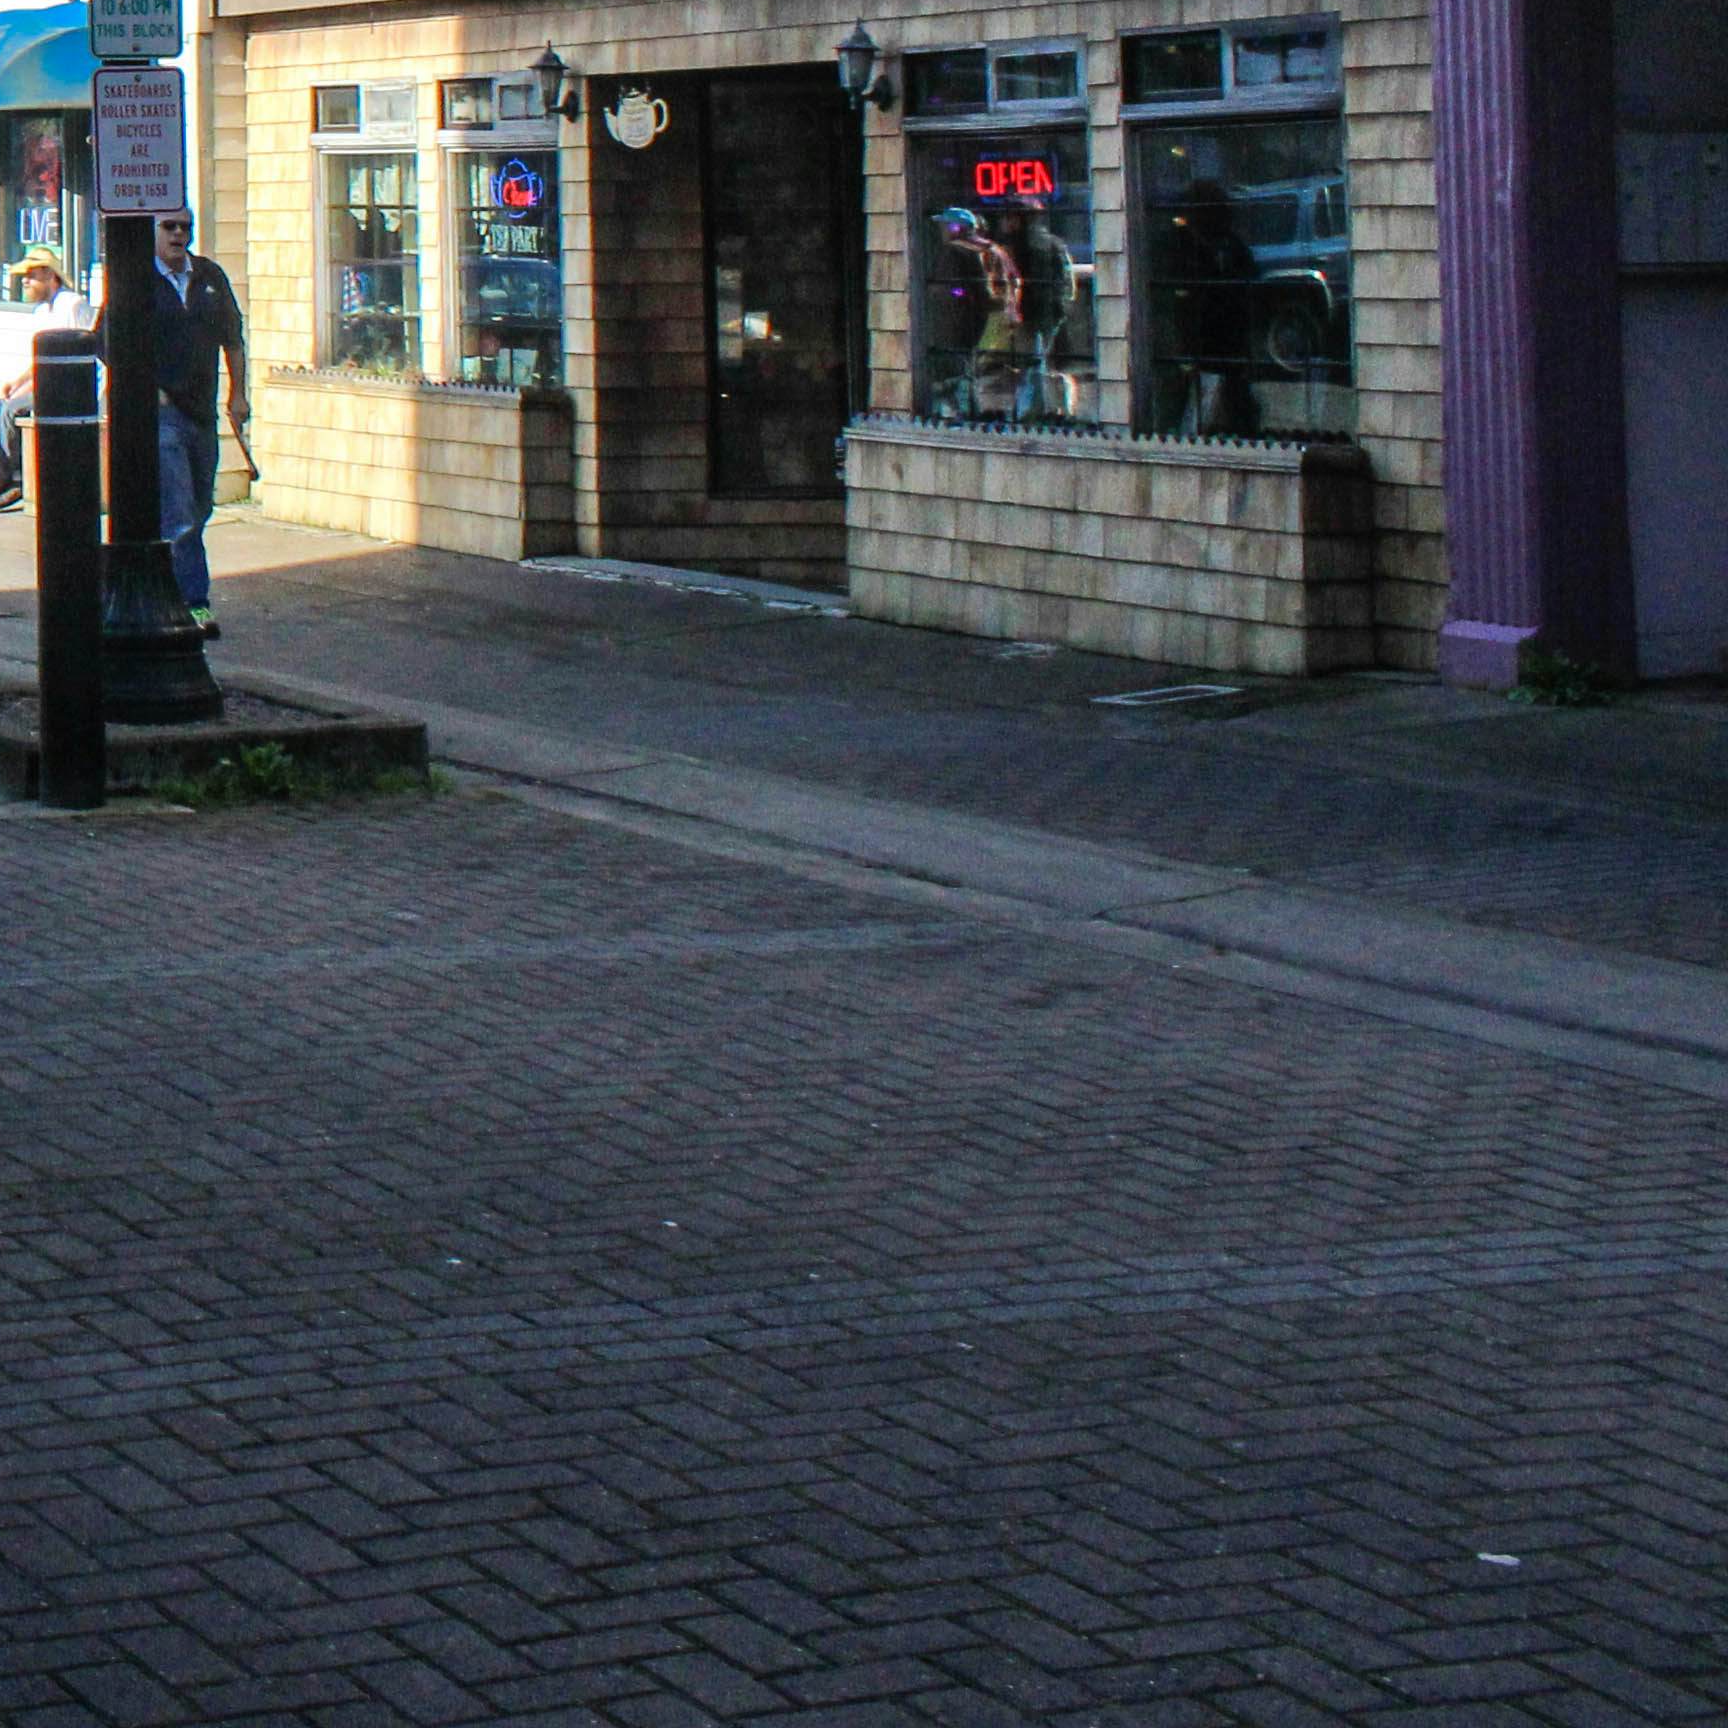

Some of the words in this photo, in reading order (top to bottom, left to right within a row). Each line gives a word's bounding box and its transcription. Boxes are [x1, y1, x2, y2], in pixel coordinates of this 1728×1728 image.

[95, 24, 125, 38] THIS
[132, 24, 175, 38] BLOCK
[104, 84, 172, 99] SKATEBOARDS
[101, 104, 137, 118] ROLLER
[141, 104, 176, 118] SKATES
[116, 124, 162, 138] BICYCLES
[131, 143, 150, 157] ARE
[111, 163, 170, 178] PROHIBITED
[976, 160, 1054, 196] OPEN
[19, 207, 59, 244] LIVE
